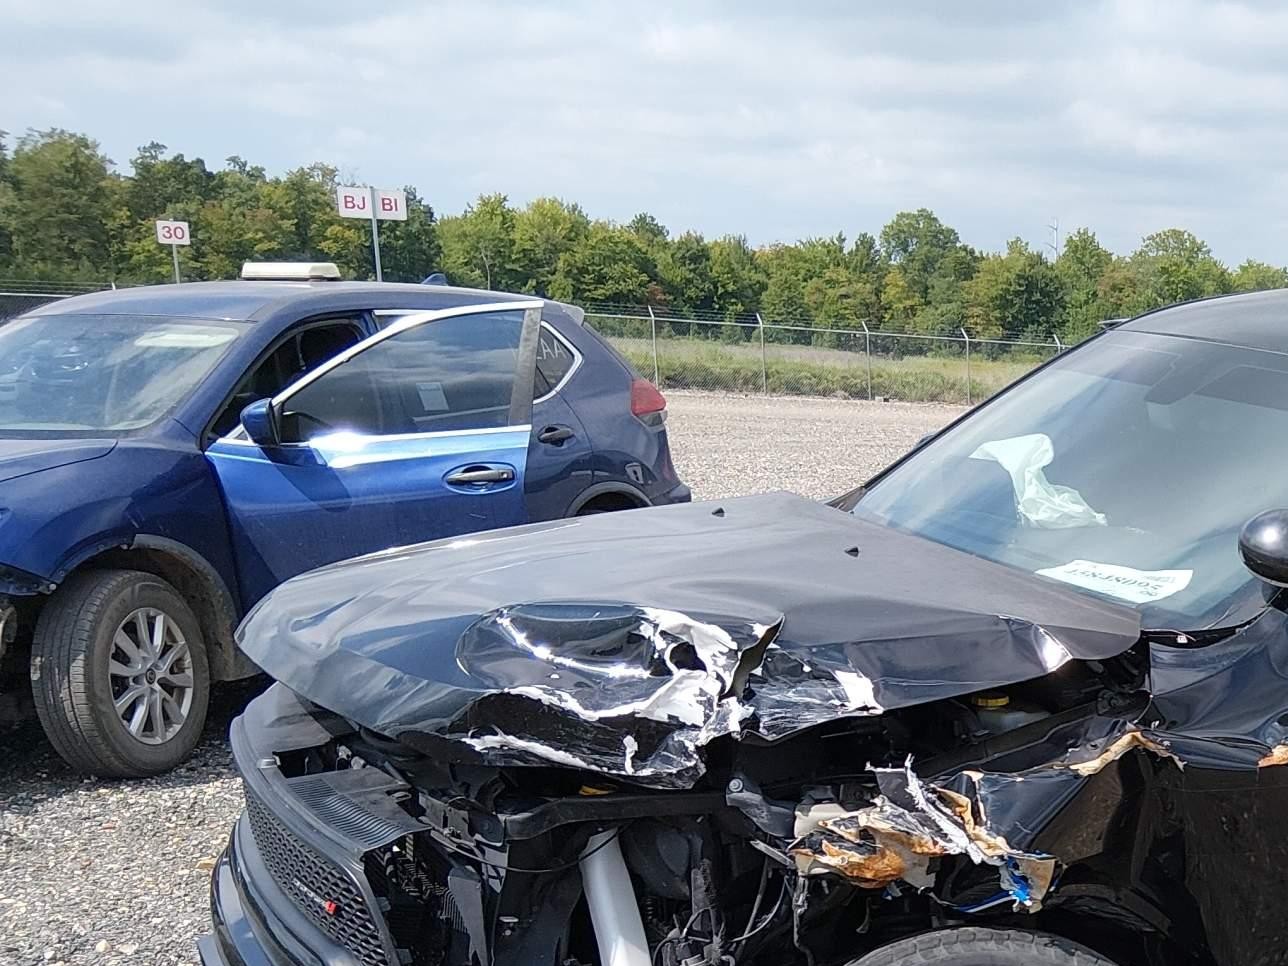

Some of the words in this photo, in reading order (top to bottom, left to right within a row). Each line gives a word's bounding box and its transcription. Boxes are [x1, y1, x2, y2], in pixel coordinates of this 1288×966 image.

[344, 195, 366, 210] BJ
[381, 197, 398, 212] BI
[161, 225, 185, 240] 30
